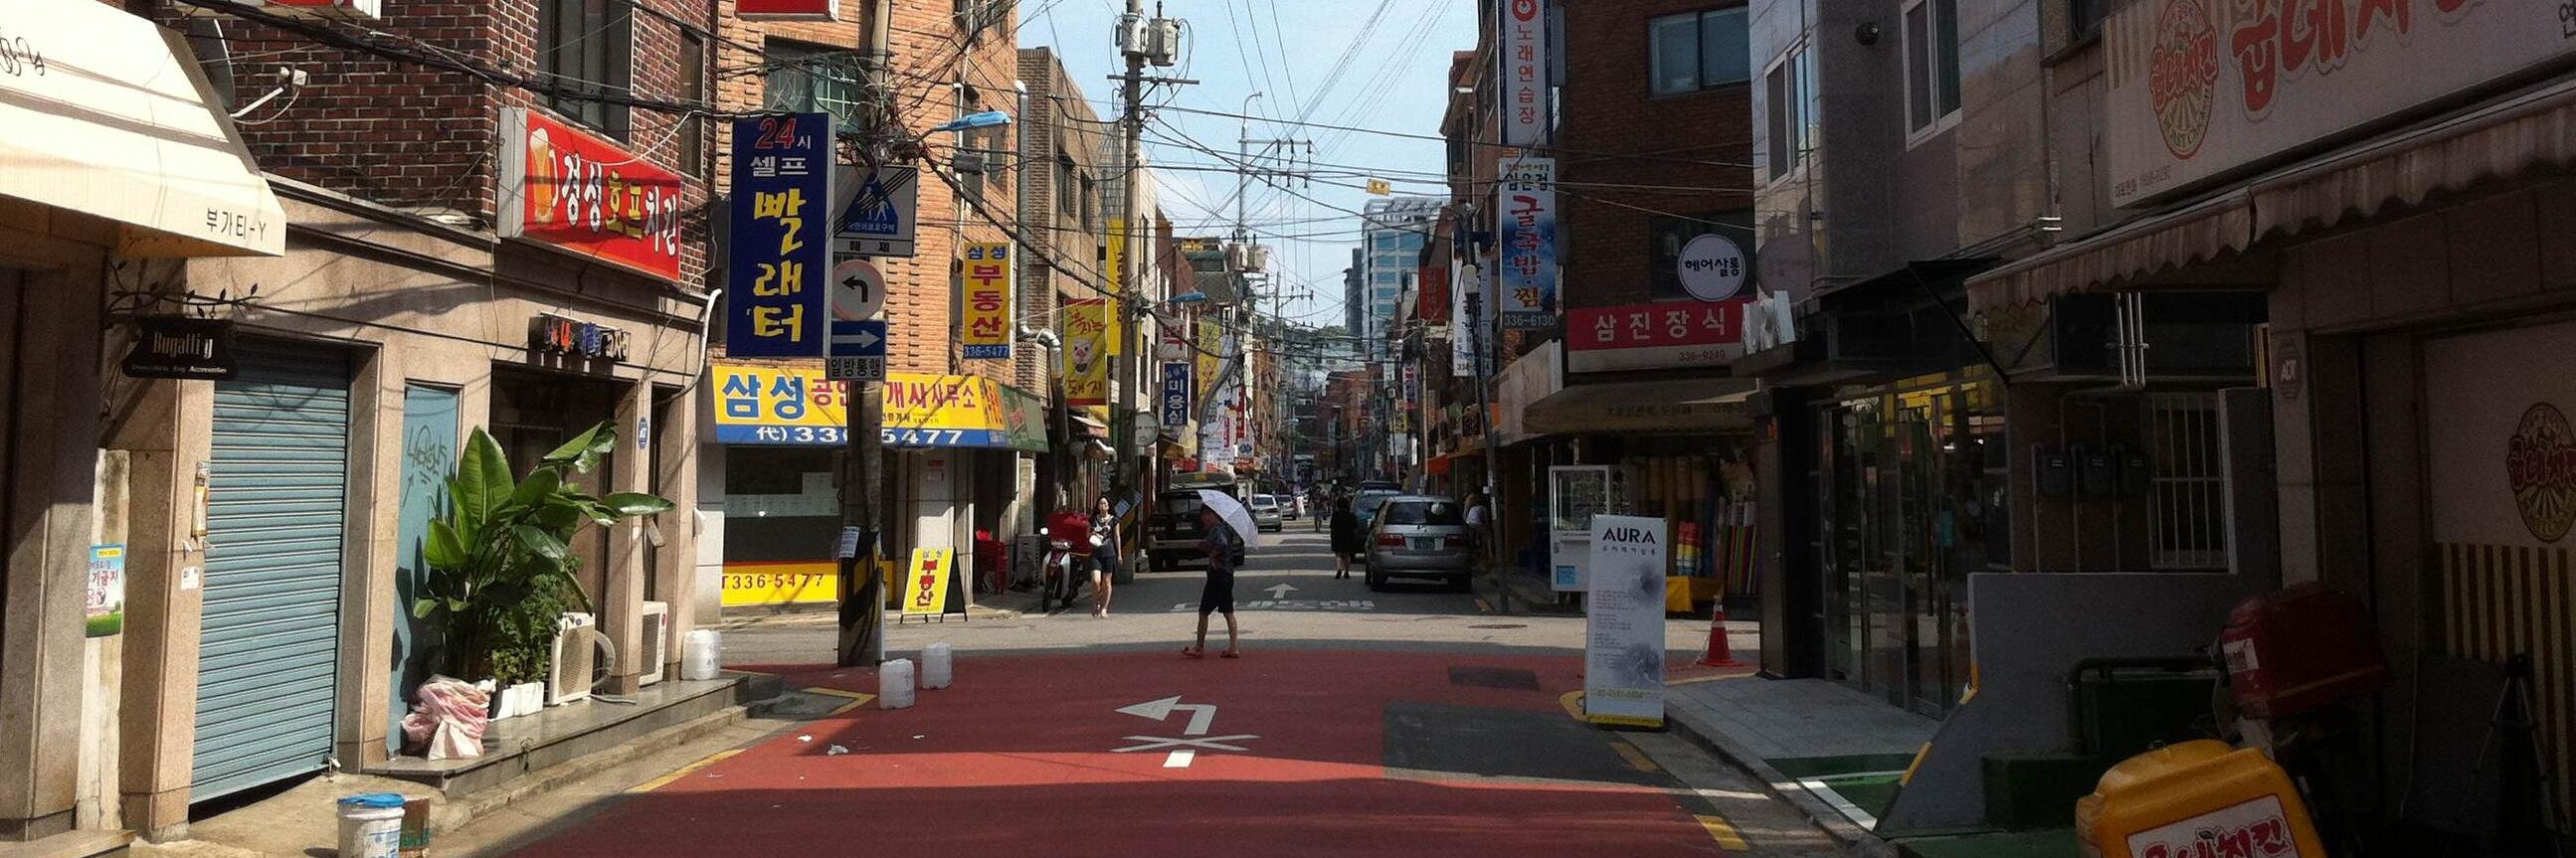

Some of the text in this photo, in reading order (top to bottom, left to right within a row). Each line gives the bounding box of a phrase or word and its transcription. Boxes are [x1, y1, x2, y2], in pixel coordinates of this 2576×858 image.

[1517, 24, 1536, 125] 노래연습장
[750, 155, 809, 177] 셀프
[207, 208, 267, 241] 부가티-Y
[753, 188, 807, 342] 빨래터
[1684, 257, 1741, 277] 헤어살롱
[971, 264, 1003, 338] 부동산
[1594, 307, 1726, 342] 삼진장식
[830, 358, 881, 377] 일방통행
[722, 374, 806, 420] 삼성
[1168, 378, 1186, 426] 미용실
[1602, 526, 1656, 545] AURA
[916, 559, 938, 606] 부동산
